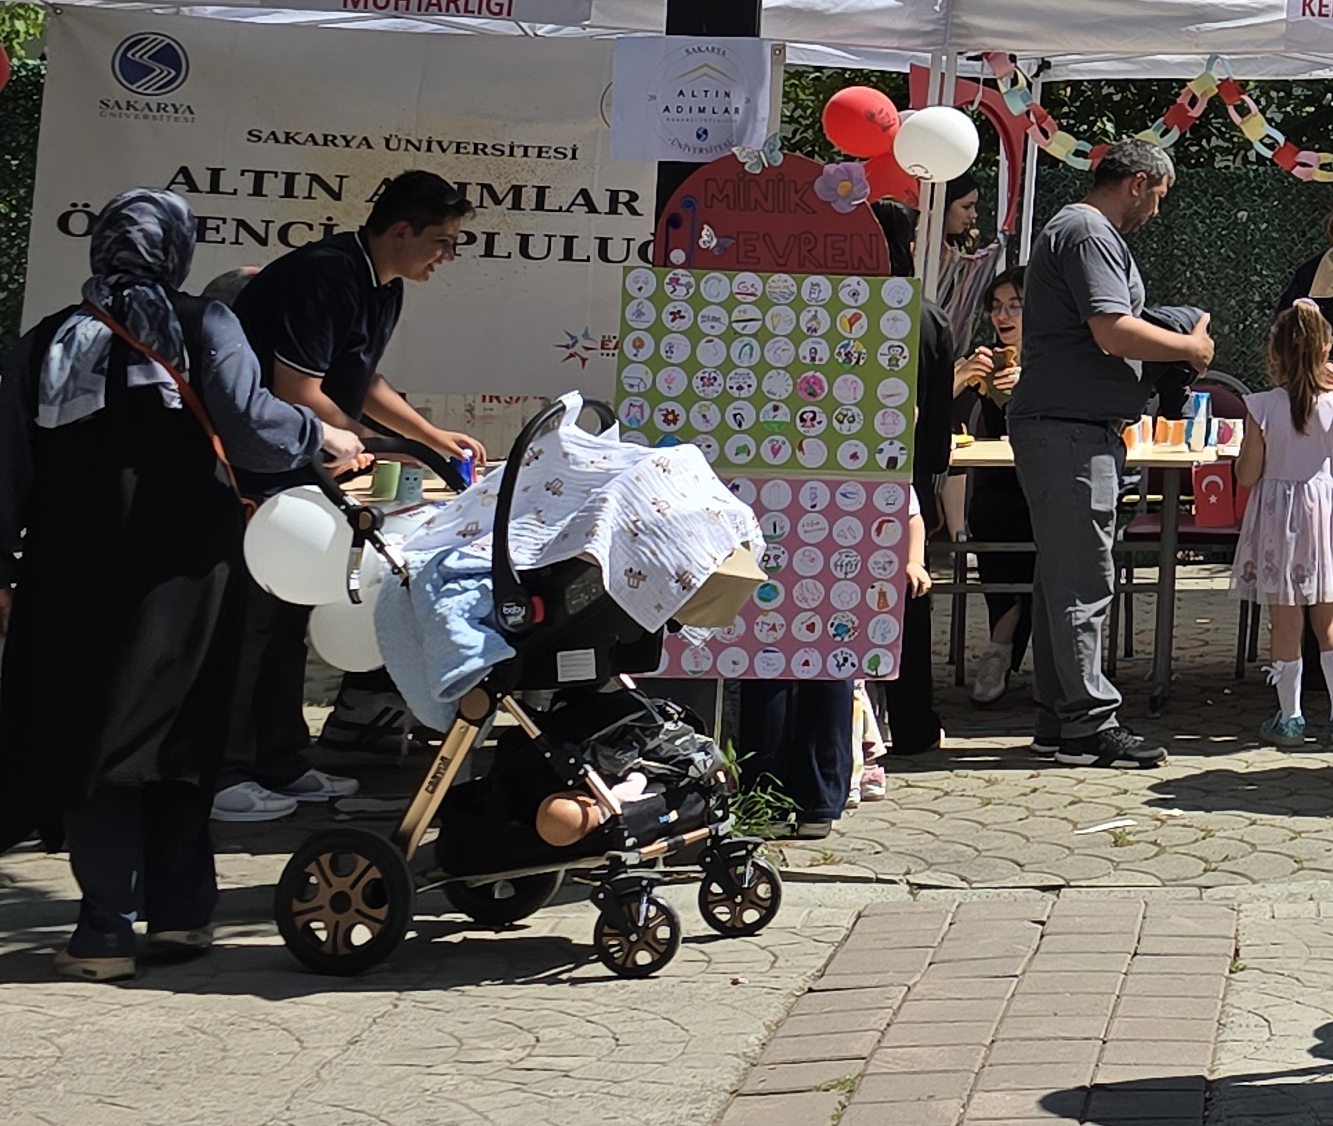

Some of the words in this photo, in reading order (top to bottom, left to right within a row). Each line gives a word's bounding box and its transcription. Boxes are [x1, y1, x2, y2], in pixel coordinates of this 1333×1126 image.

[99, 98, 195, 115] SAKARYA
[662, 105, 740, 116] ADIMLAR
[677, 88, 731, 99] ALTIN
[246, 128, 374, 149] SAKARYA
[383, 133, 579, 161] ÜNİVERSİTESİ
[164, 165, 350, 202] ALTIN
[365, 177, 644, 217] AIMLAR
[704, 173, 817, 215] MİNİK
[56, 201, 341, 249] ÖENCİ
[735, 231, 880, 270] EVREN
